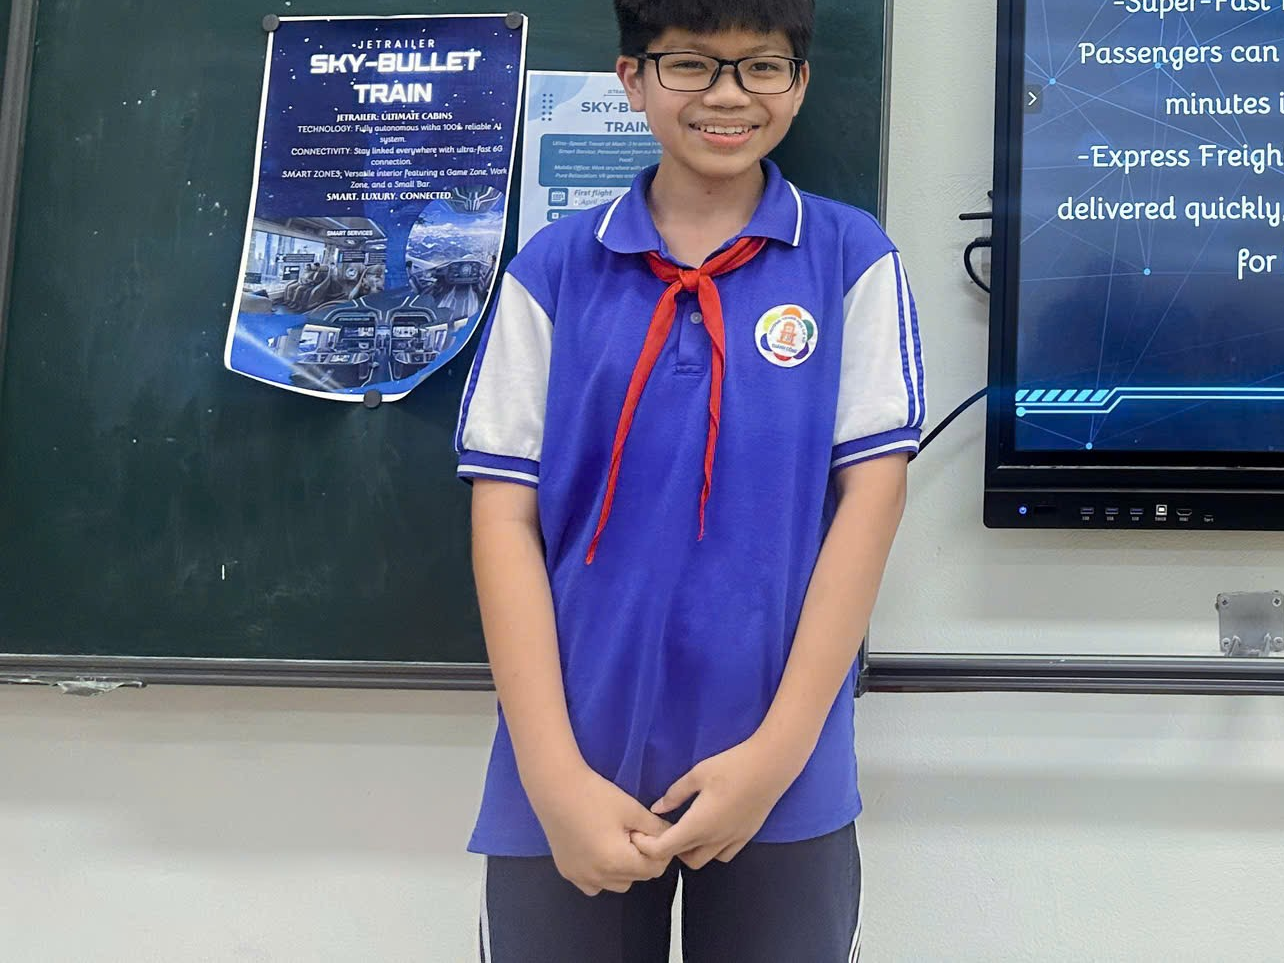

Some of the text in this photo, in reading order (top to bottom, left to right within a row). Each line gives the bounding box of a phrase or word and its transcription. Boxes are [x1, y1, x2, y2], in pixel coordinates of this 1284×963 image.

[358, 39, 435, 49] JETRAILER
[1079, 42, 1222, 69] Passengers
[1230, 43, 1280, 62] can
[310, 50, 481, 74] SKY-BULLET
[353, 83, 433, 103] TRAIN
[1166, 93, 1271, 115] minutes
[336, 111, 453, 122] JETRAILER: ULTIMATE CABINS
[298, 125, 353, 133] TECHNOLOGY:
[355, 124, 372, 134] Fully
[604, 121, 649, 132] TRAIN
[380, 135, 406, 144] system.
[291, 147, 352, 156] CONNECTIVITY:
[354, 146, 370, 157] Stay
[372, 146, 394, 155] linked
[396, 146, 437, 157] everywhere
[438, 145, 455, 154] with
[456, 145, 491, 155] ultra-fast
[370, 158, 412, 166] connection.
[1077, 146, 1190, 173] -Express
[282, 170, 312, 178] SMART
[344, 169, 375, 178] Versatile
[376, 168, 403, 177] interior
[404, 168, 437, 179] featuring
[446, 168, 468, 176] Game
[490, 167, 507, 175] Work
[372, 180, 385, 188] and
[394, 180, 414, 188] Small
[327, 190, 453, 201] SMART. LUXURY. CONNECTED.
[1057, 197, 1176, 221] delivered
[1237, 248, 1277, 279] for
